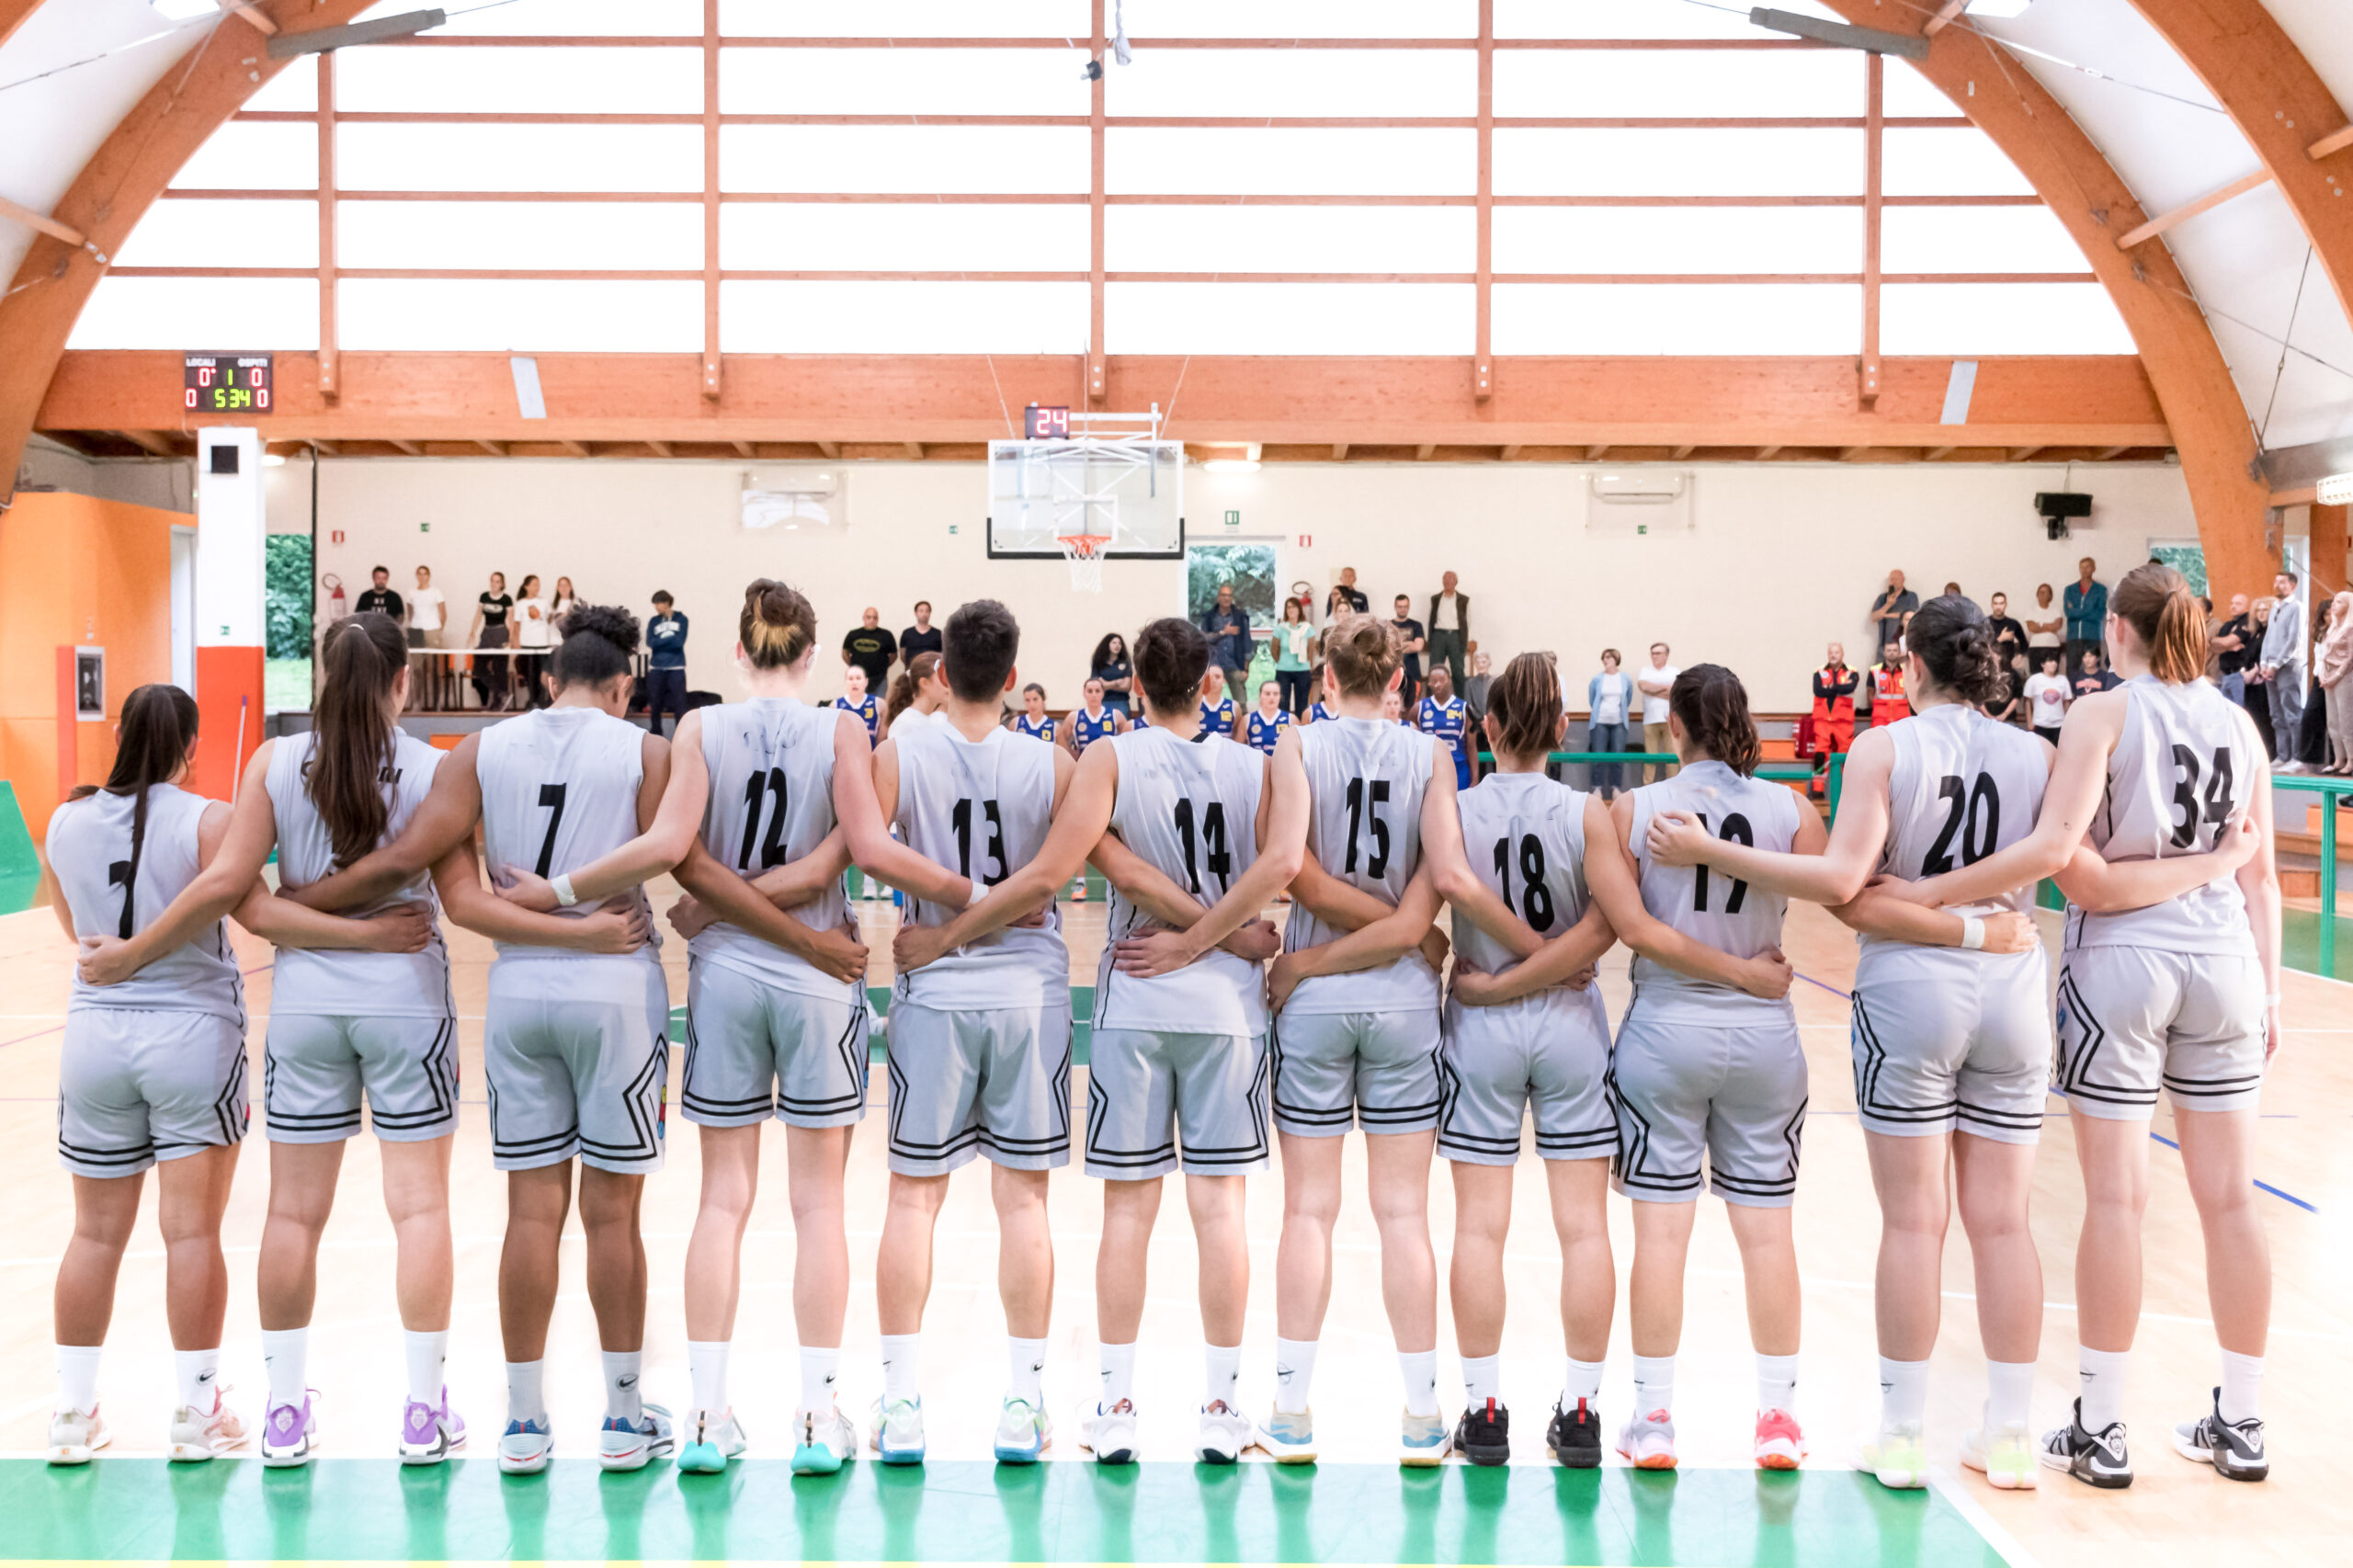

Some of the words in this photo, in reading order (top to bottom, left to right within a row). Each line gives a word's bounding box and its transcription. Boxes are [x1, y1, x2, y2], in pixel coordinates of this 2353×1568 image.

[186, 388, 197, 408] 0
[256, 388, 268, 408] 0
[199, 368, 210, 387] 0
[251, 368, 263, 387] 0
[1036, 408, 1067, 435] 24
[535, 783, 567, 881] 7
[738, 767, 788, 870] 12
[952, 798, 1009, 887] 13
[1345, 777, 1390, 880] 15
[1920, 771, 2000, 877] 20
[2170, 744, 2234, 851] 34
[1174, 798, 1230, 896] 14
[1493, 834, 1555, 932] 18
